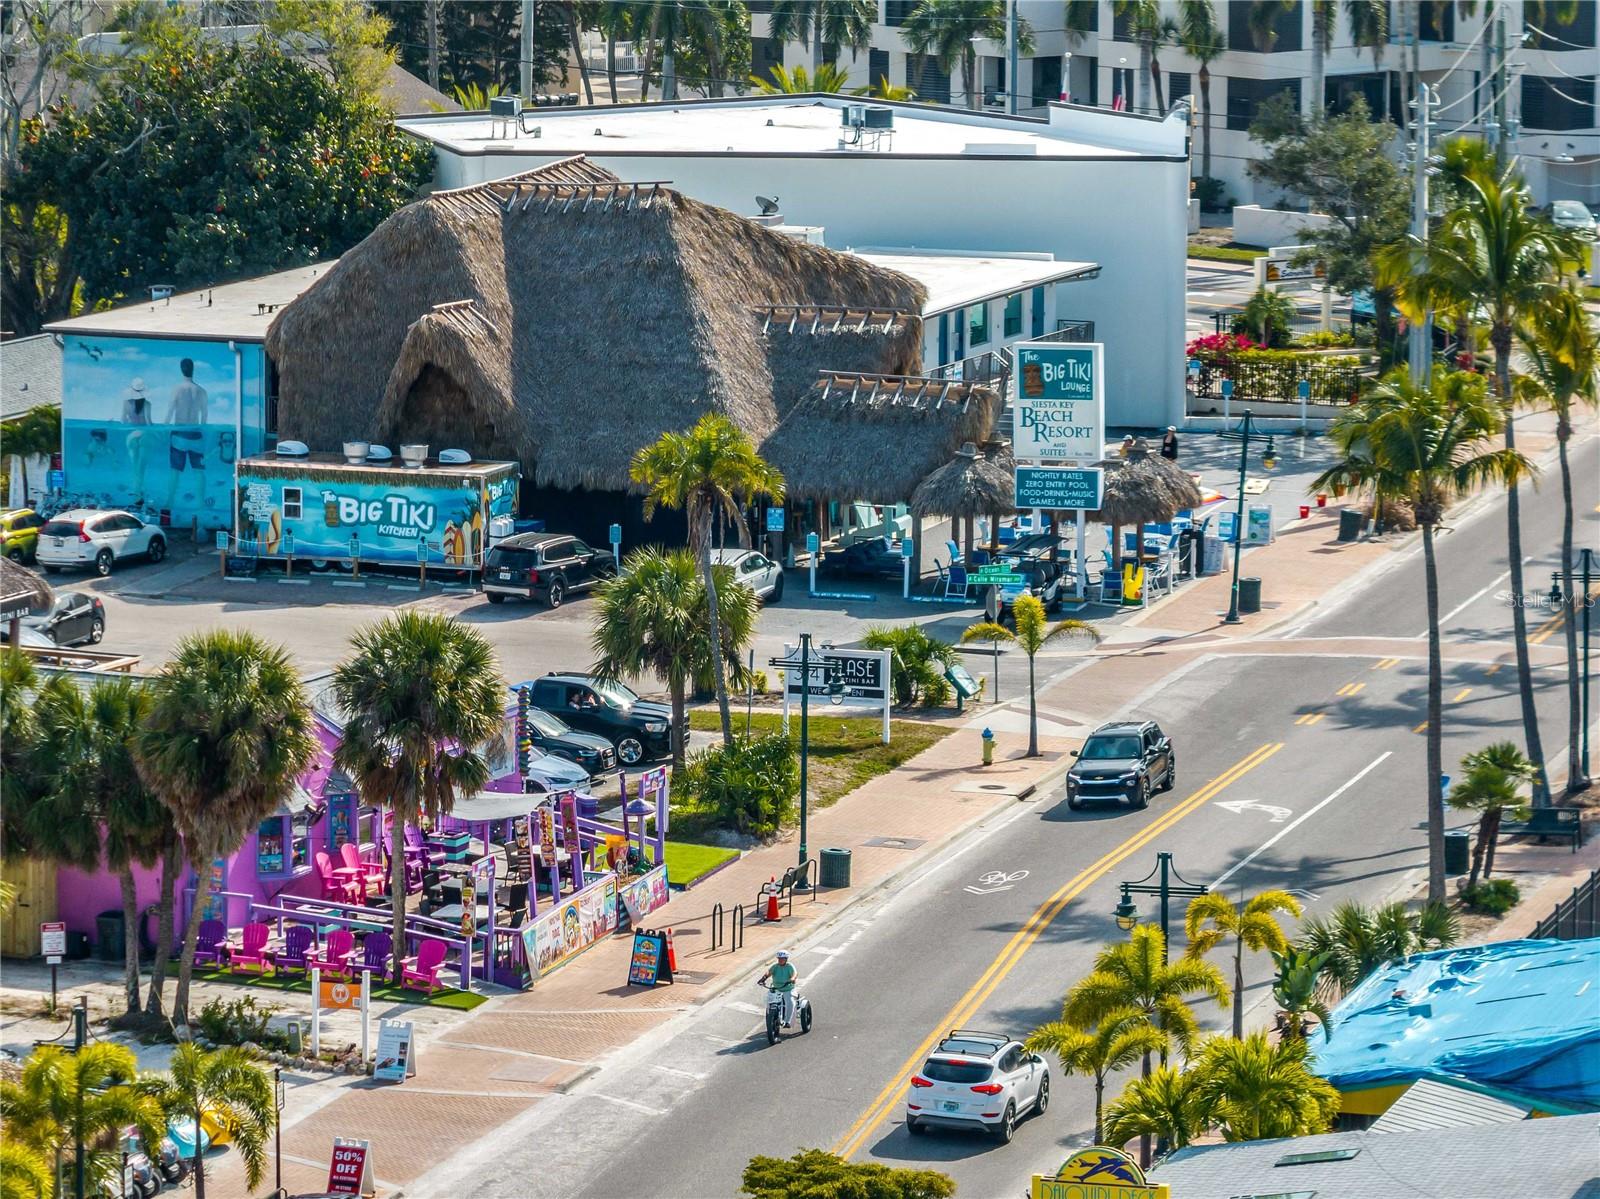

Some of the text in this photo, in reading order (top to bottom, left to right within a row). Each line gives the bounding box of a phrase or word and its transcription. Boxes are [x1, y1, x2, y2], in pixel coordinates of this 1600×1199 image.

[1021, 351, 1040, 363] The
[1042, 359, 1091, 382] BIG TIKI
[1061, 381, 1091, 392] LOUNGE
[1020, 407, 1073, 427] BEACH
[1032, 422, 1093, 443] RESORT
[338, 496, 434, 530] BIG TIKI
[378, 524, 418, 537] KITCHEN
[16, 607, 29, 617] BAR
[335, 1151, 363, 1162] 50%
[336, 1163, 358, 1174] OFF
